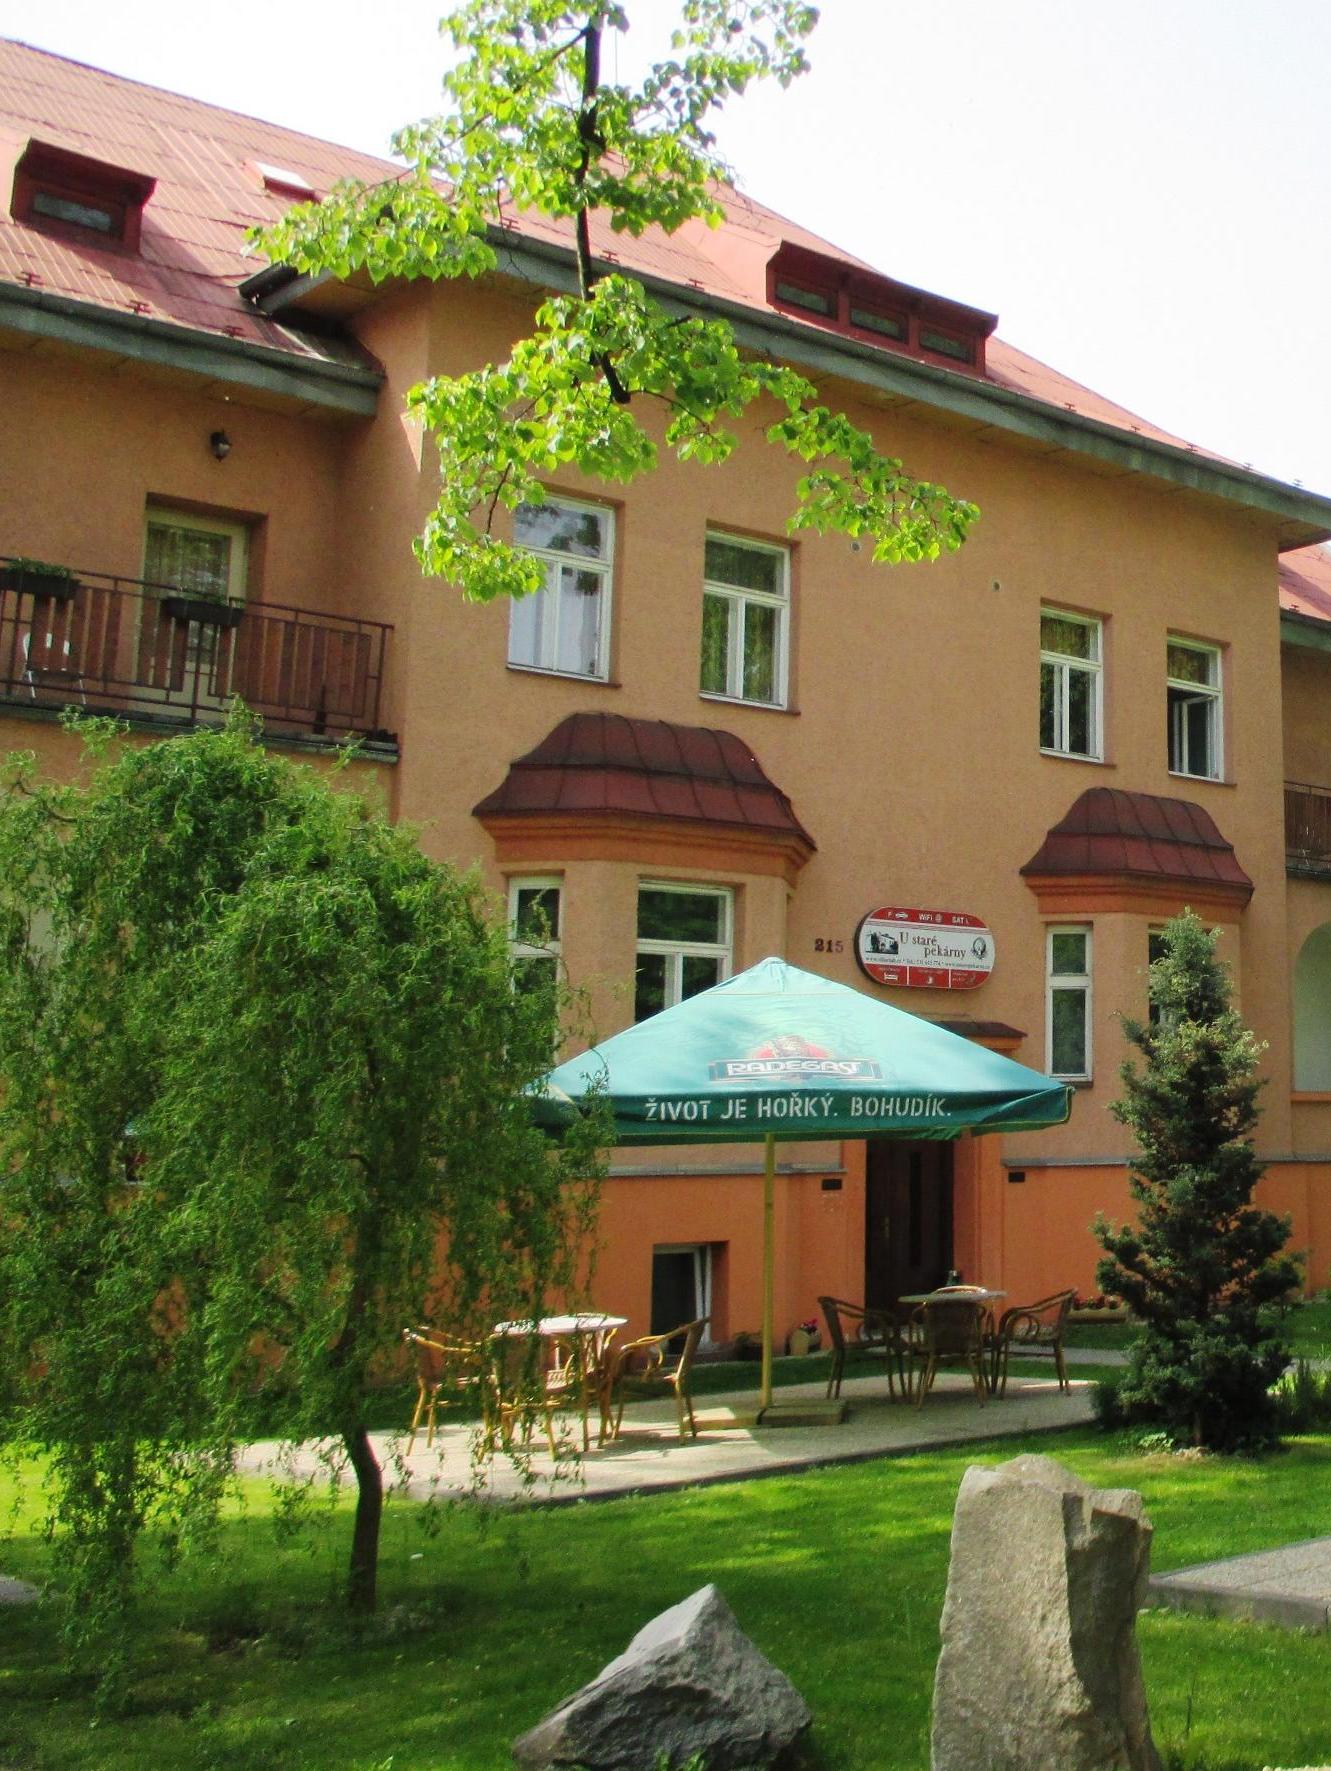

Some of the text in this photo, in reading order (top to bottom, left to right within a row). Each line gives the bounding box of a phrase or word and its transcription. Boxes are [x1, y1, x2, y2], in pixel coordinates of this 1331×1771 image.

[899, 931, 938, 946] U staré
[924, 944, 966, 959] pekárny
[726, 1060, 861, 1076] RADEGAST
[645, 1091, 951, 1121] ŽIVOT JE HOŘKÝ. BOHUDÍK.
